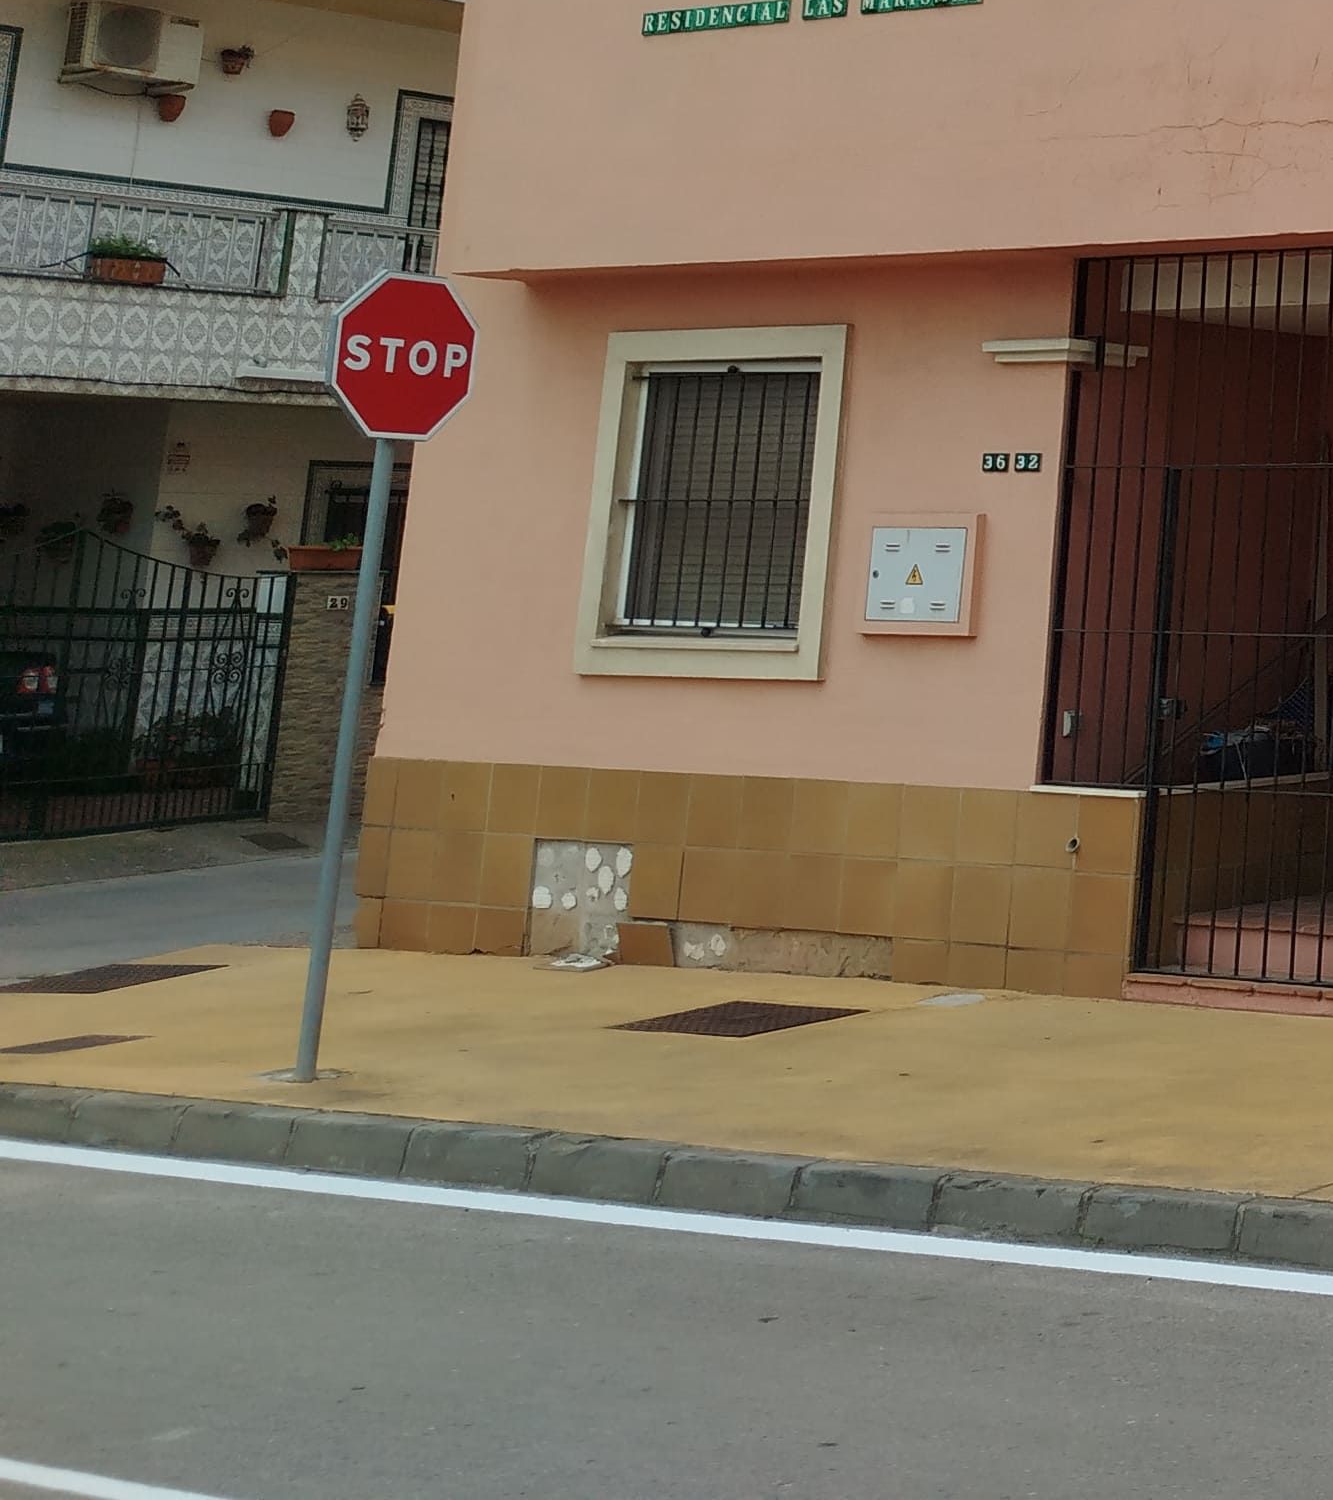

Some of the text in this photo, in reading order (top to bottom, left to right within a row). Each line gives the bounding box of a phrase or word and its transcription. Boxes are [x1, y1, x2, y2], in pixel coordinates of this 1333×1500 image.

[643, 0, 787, 33] RESIDENCIAL
[343, 334, 468, 378] STOP
[983, 454, 1040, 470] 36 32
[329, 596, 348, 609] 29
